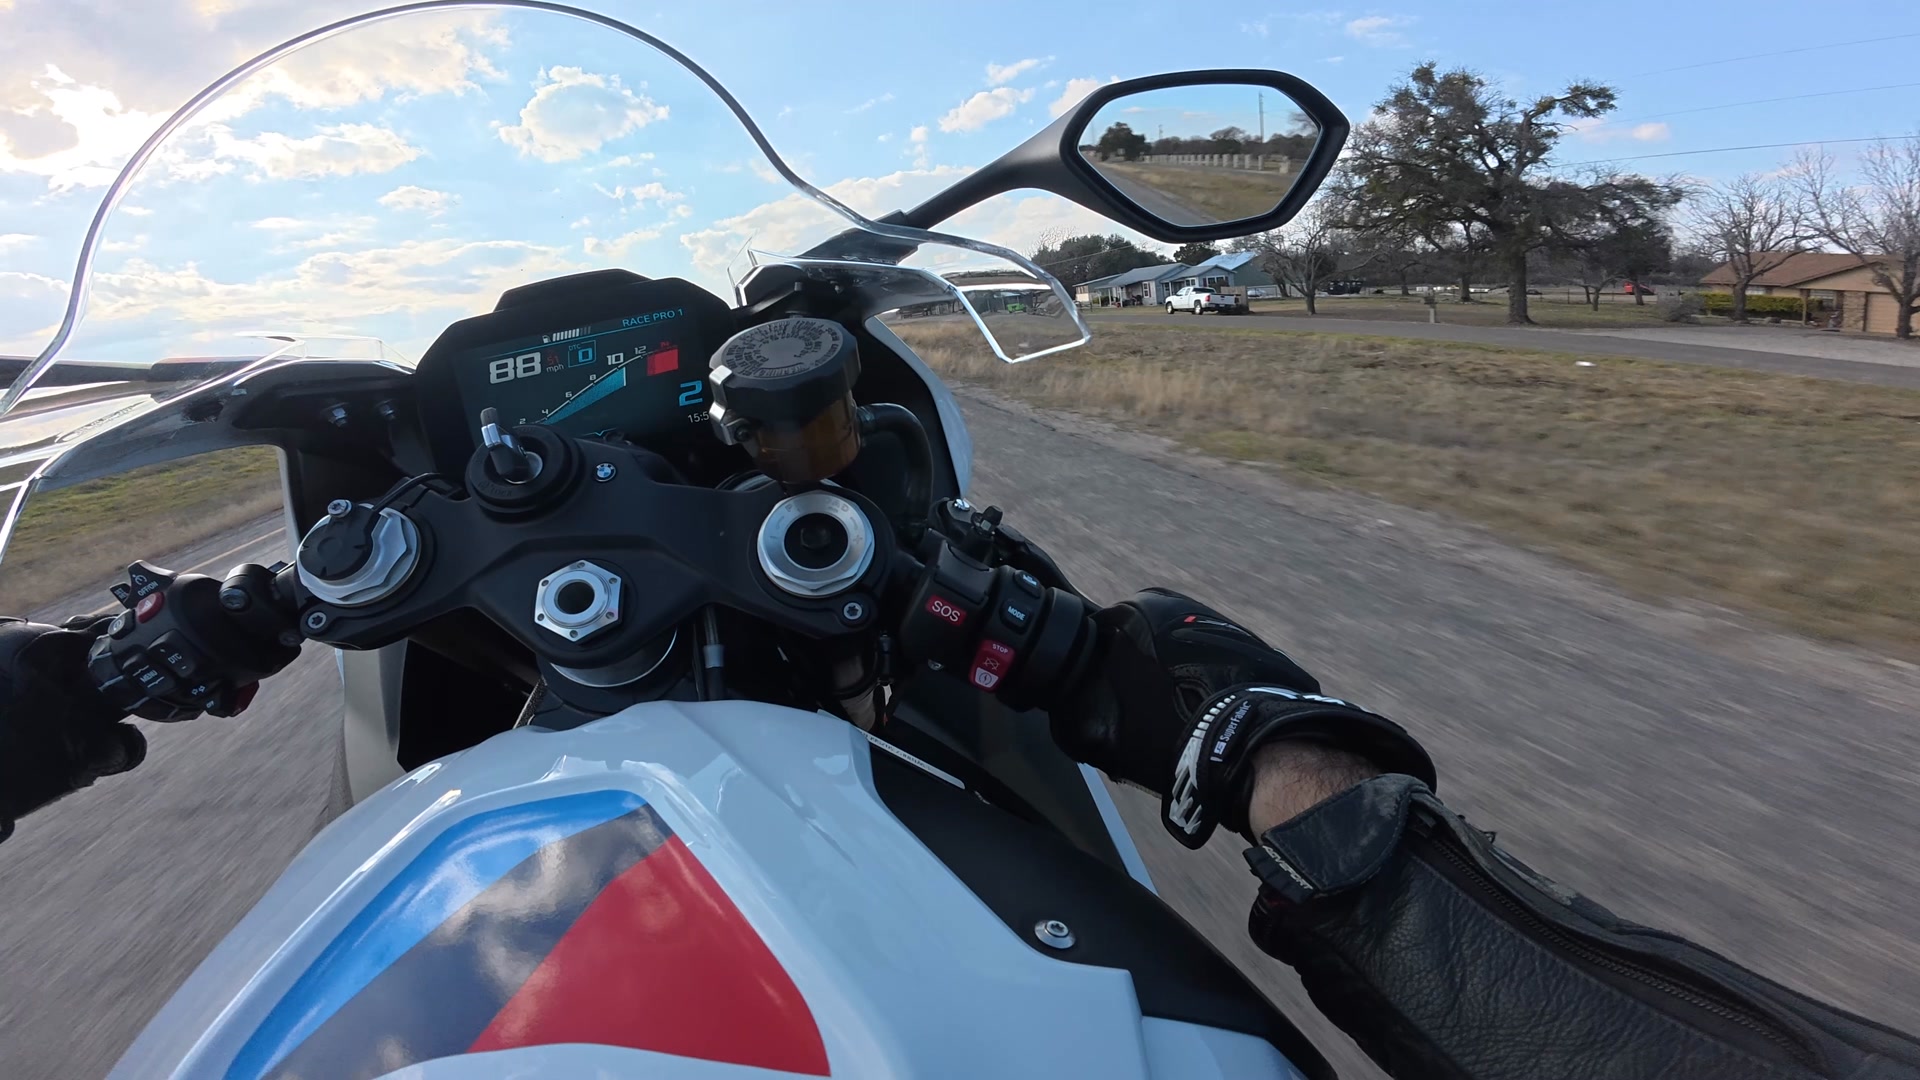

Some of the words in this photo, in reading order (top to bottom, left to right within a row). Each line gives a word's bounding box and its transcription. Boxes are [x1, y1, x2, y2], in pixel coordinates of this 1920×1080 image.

[622, 314, 650, 327] RACE
[652, 310, 675, 321] PRO
[678, 308, 683, 316] 1
[578, 347, 593, 362] 0
[634, 345, 647, 355] 12
[607, 353, 624, 366] 10
[489, 352, 541, 384] 88
[546, 363, 565, 373] mph
[679, 380, 703, 407] 2
[688, 411, 710, 423] 15:5
[932, 600, 960, 621] SOS
[1008, 606, 1025, 620] MODE
[992, 644, 1008, 653] STOP
[168, 653, 182, 664] DTC
[140, 669, 158, 683] MENU
